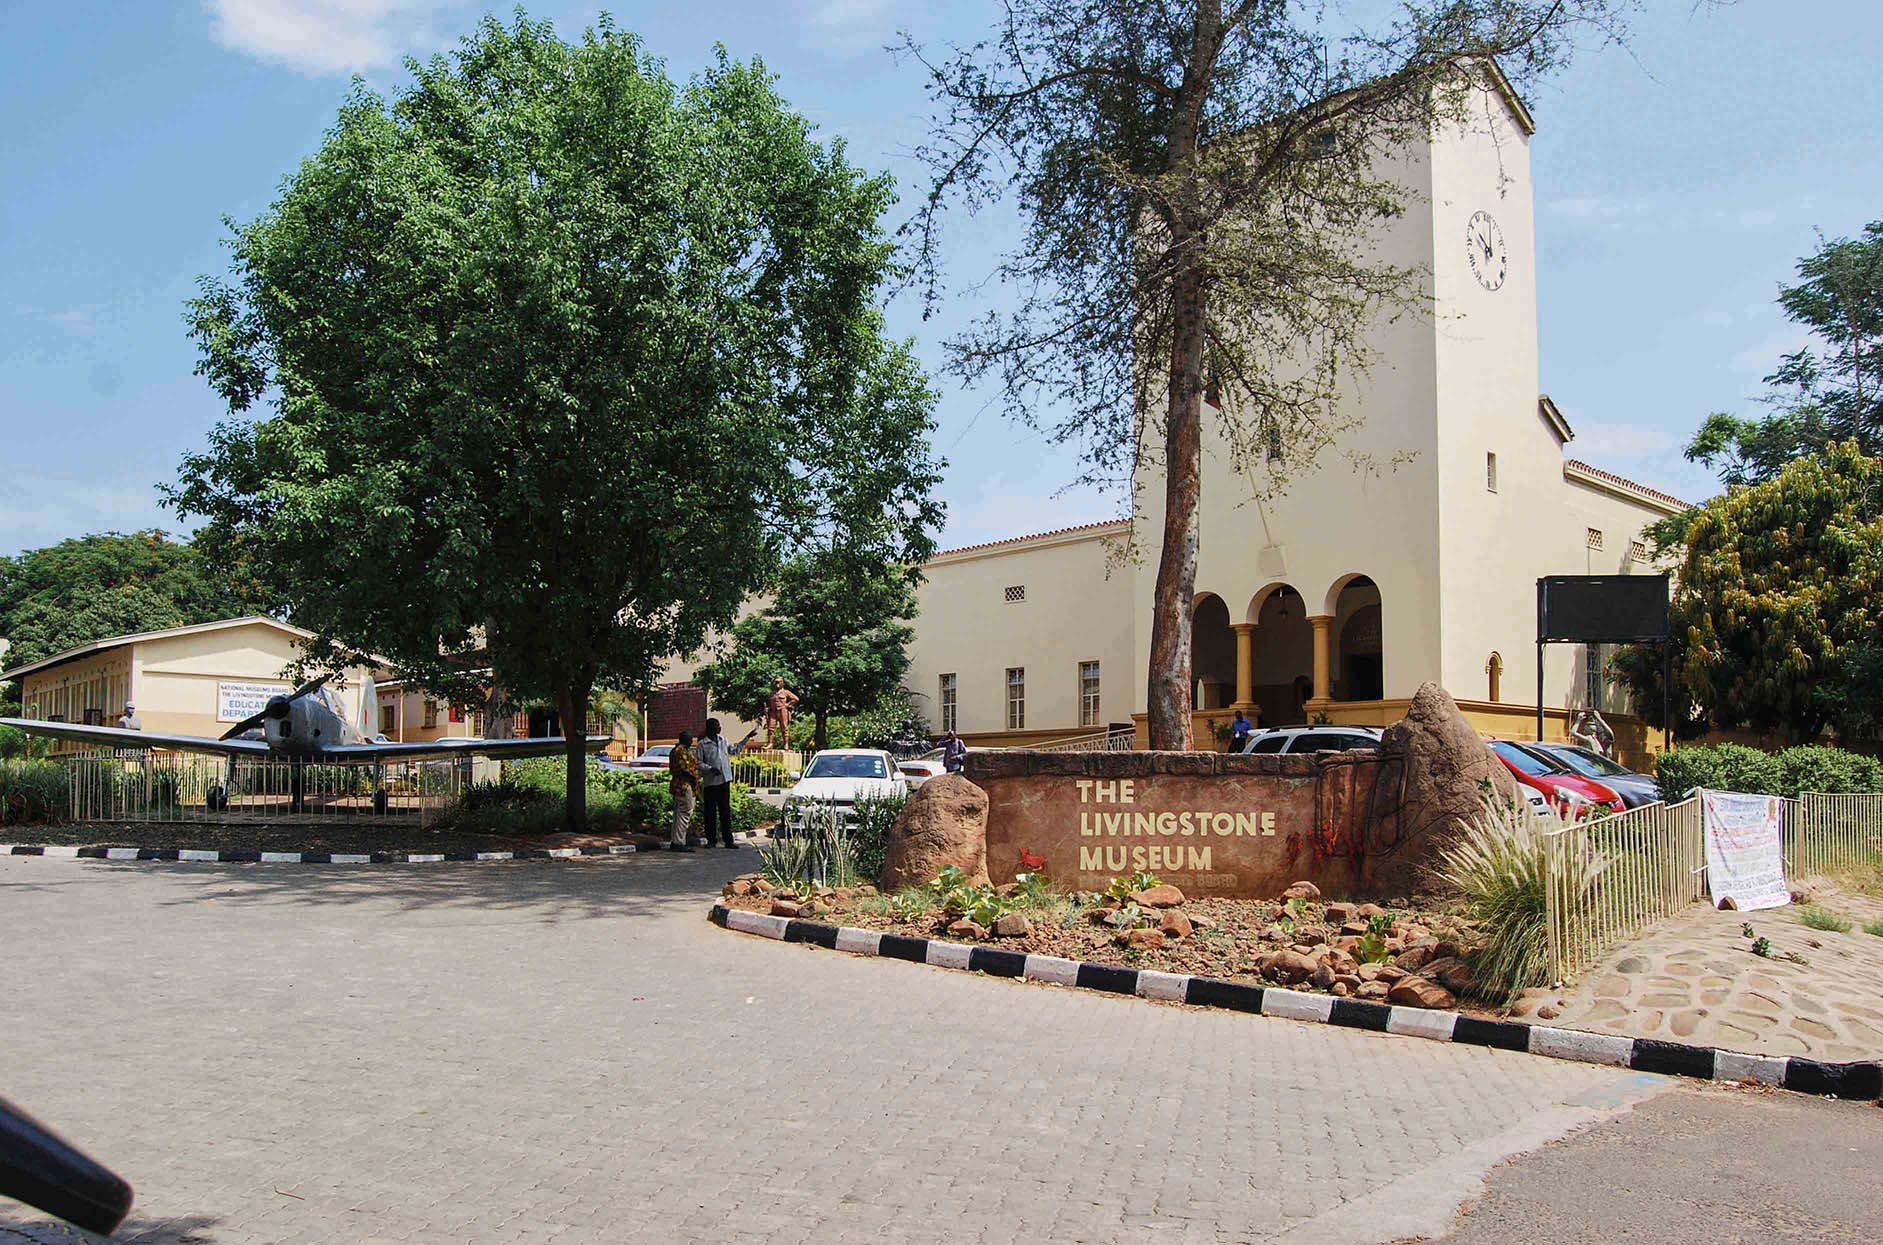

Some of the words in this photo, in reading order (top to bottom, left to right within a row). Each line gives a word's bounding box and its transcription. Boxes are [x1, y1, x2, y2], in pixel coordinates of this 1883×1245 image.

[1076, 780, 1135, 803] THE
[1080, 811, 1276, 836] LIVINGSTONE
[1079, 846, 1212, 871] MUSEUM
